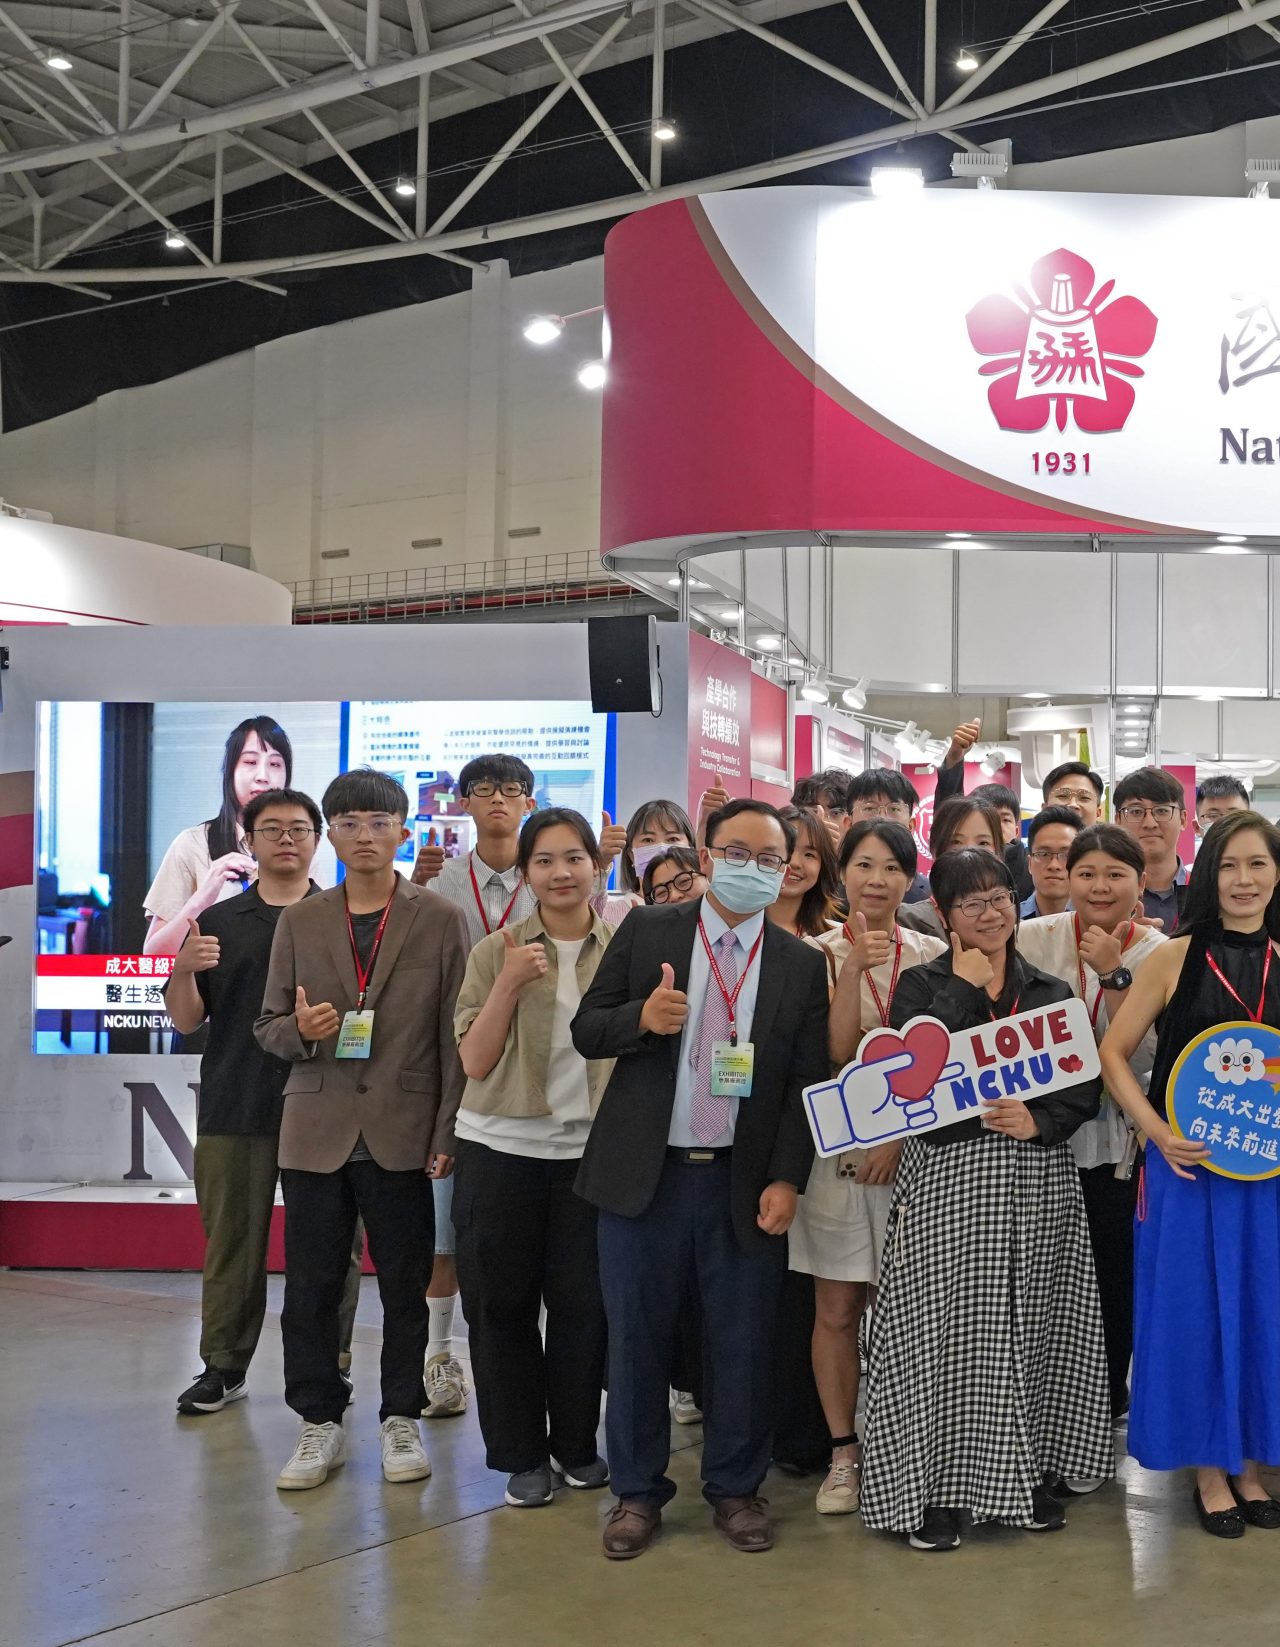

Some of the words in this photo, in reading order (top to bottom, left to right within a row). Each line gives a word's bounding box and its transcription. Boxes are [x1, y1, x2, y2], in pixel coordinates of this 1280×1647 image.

[1032, 452, 1090, 475] 1931
[706, 675, 737, 713] 產學合作
[701, 708, 740, 747] 與技轉績效
[700, 746, 722, 761] Technology
[104, 1015, 141, 1028] NCKU
[142, 1015, 175, 1028] NEW
[970, 1009, 1072, 1068] LOVE
[951, 1052, 1054, 1111] NCKU
[1189, 1116, 1278, 1161] 向未來前進
